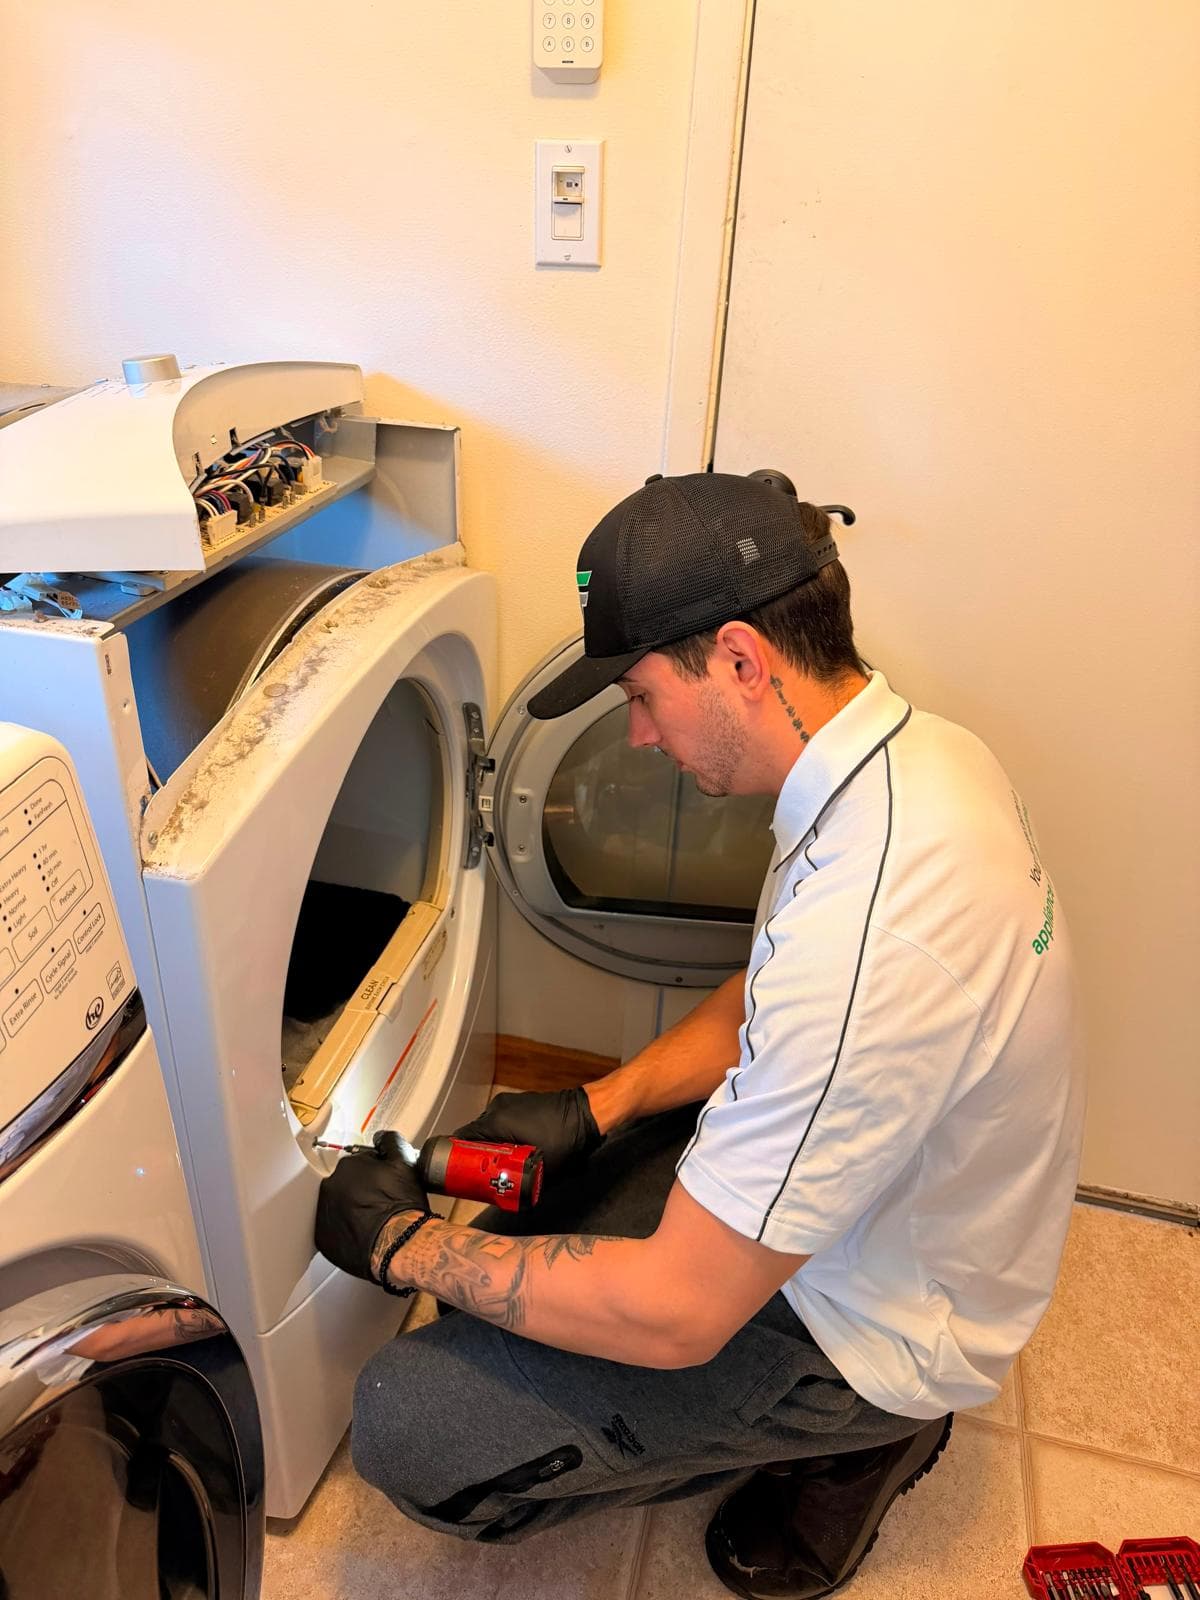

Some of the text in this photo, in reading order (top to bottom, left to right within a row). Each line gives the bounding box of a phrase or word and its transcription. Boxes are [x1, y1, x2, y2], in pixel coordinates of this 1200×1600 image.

[11, 864, 27, 880] Heavy
[3, 887, 20, 904] Heavy
[8, 895, 27, 917] Normal
[13, 912, 27, 929] Light
[28, 926, 38, 941] Soil
[361, 979, 379, 1000] CLEAN
[9, 992, 38, 1026] Extra Rinse
